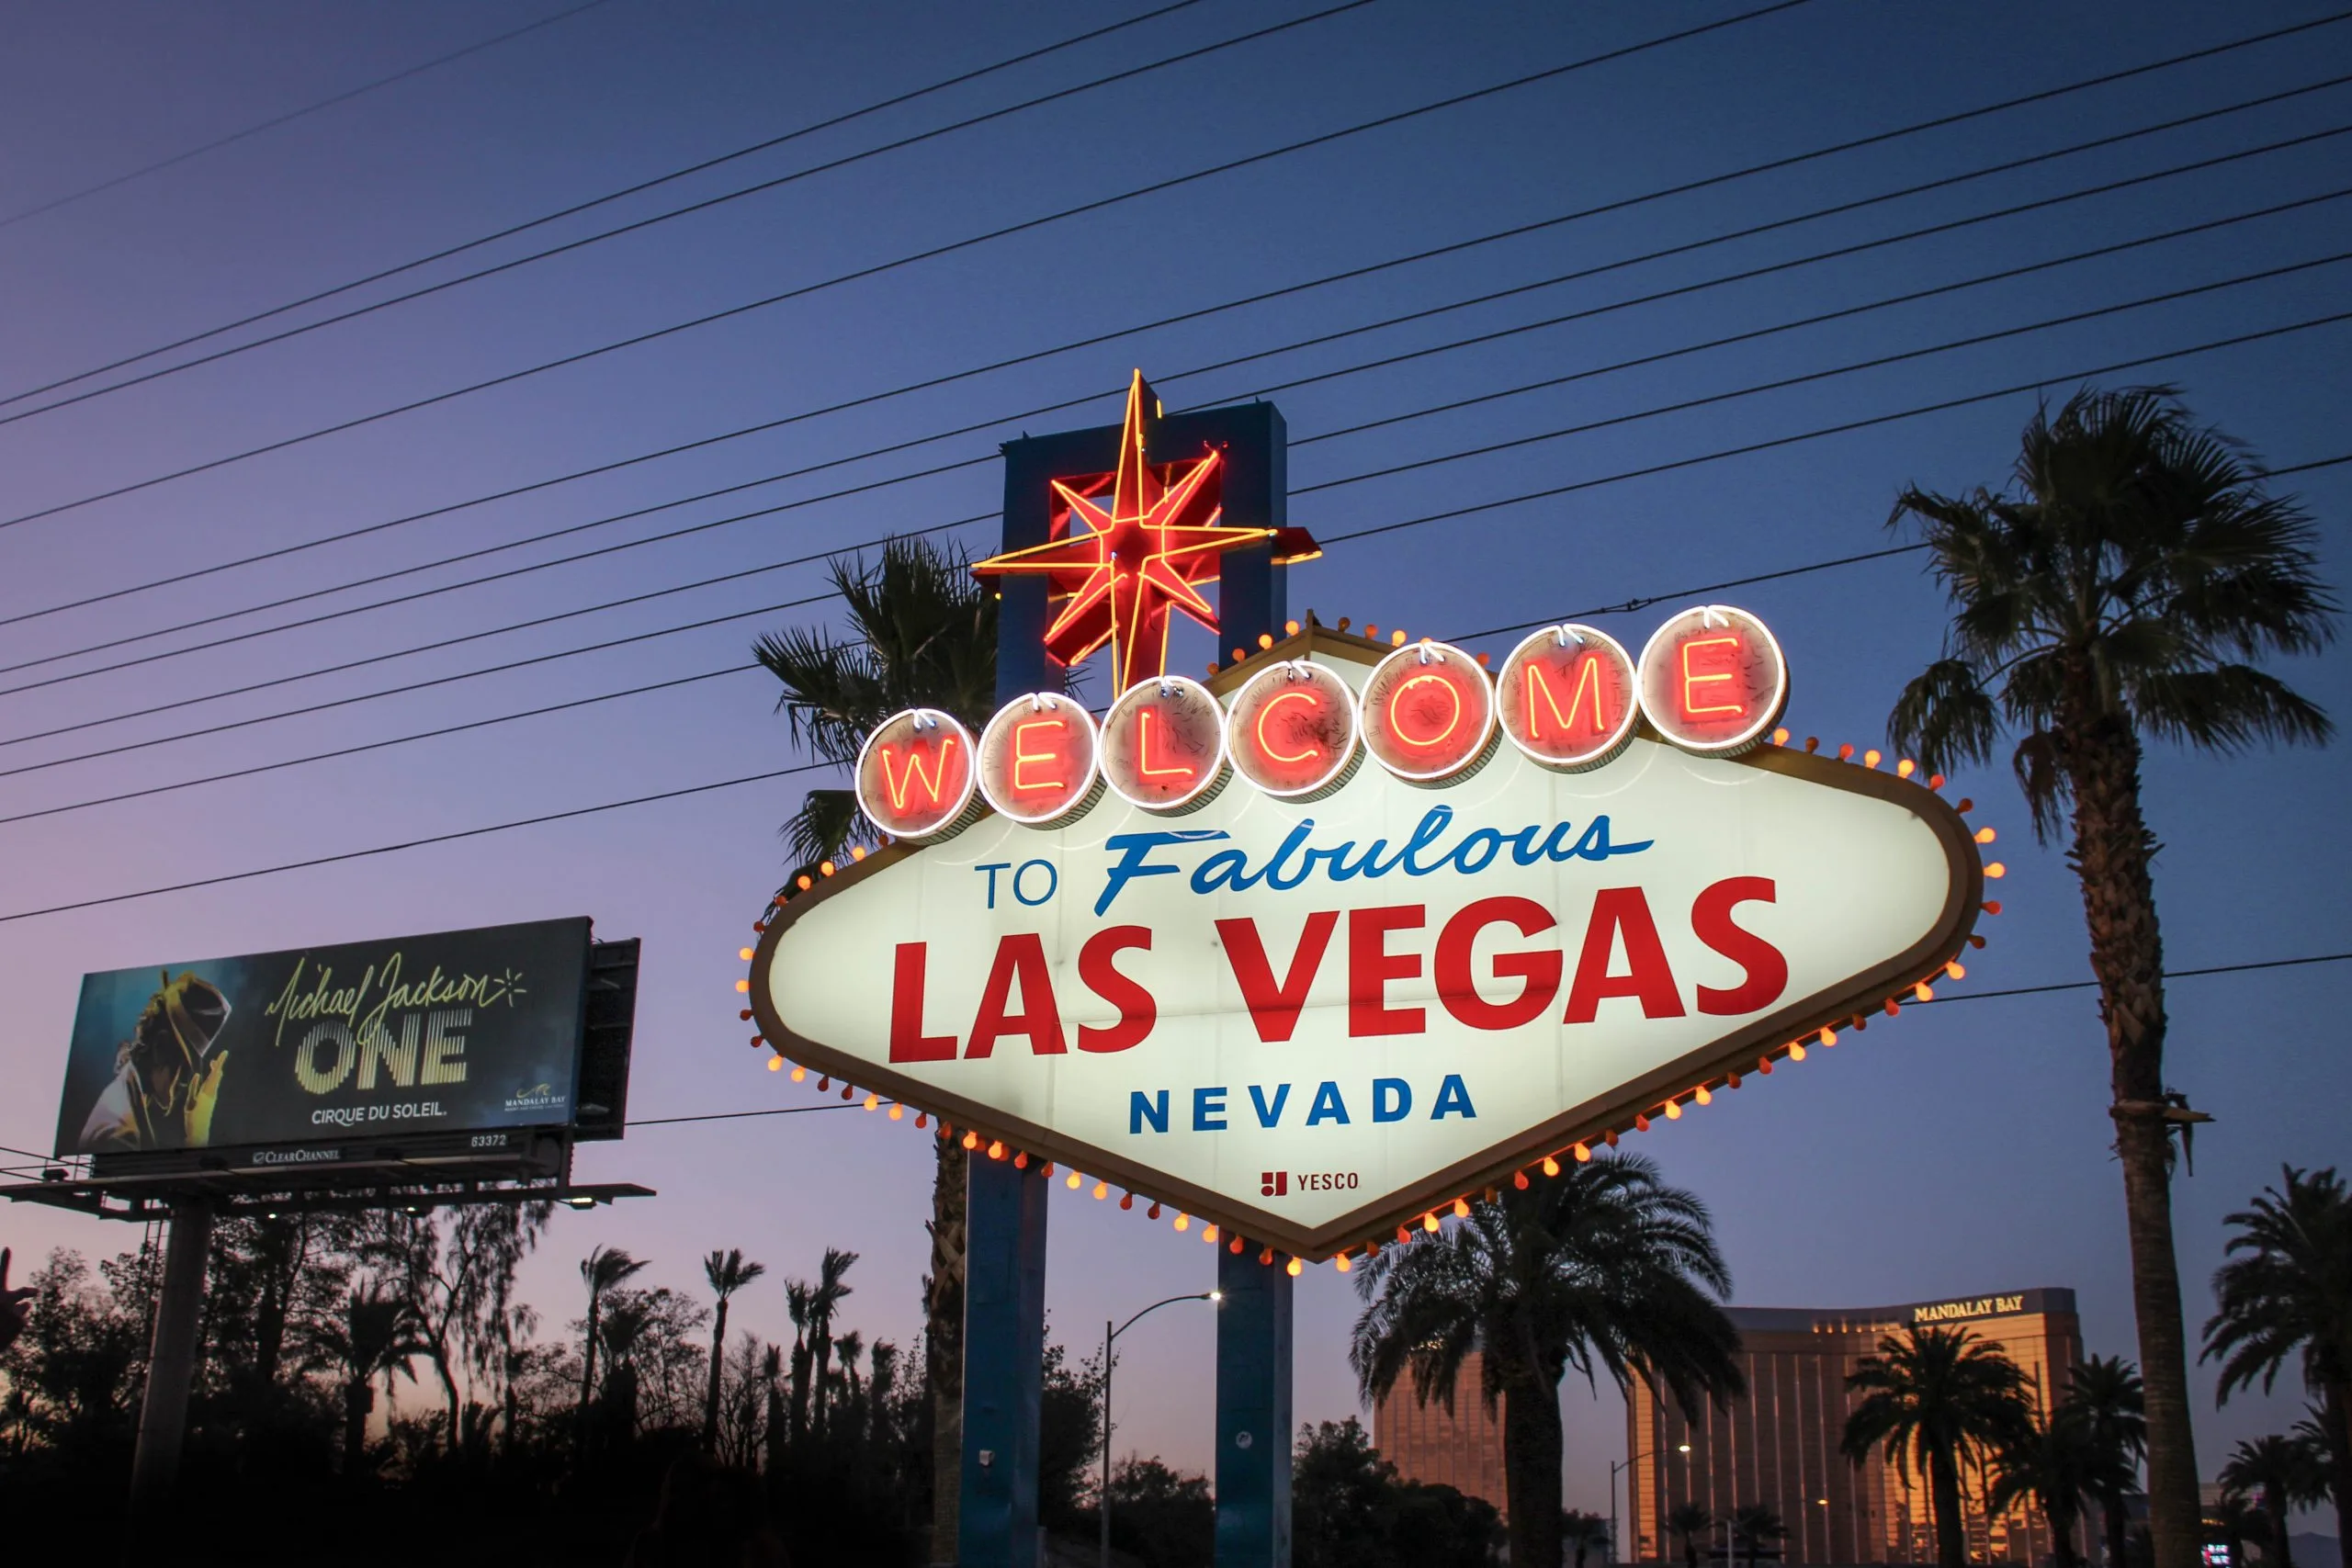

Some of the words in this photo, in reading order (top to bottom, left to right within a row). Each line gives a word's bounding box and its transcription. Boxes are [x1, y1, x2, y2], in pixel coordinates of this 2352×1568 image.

[879, 633, 1747, 815] WELCOME
[975, 860, 1057, 909] TO
[1094, 805, 1654, 917] Fabulous
[265, 957, 374, 1046] Michael
[357, 952, 508, 1044] Jackson
[888, 925, 1157, 1064] LAS
[1214, 875, 1789, 1043] VEGAS
[294, 1008, 472, 1095] ONE
[311, 1107, 365, 1127] CIRQUE
[368, 1106, 390, 1121] DU
[1129, 1074, 1476, 1134] NEVADA
[1297, 1172, 1359, 1190] YESCO
[1915, 1299, 1993, 1323] MANDALAY
[1996, 1295, 2023, 1313] BAY
